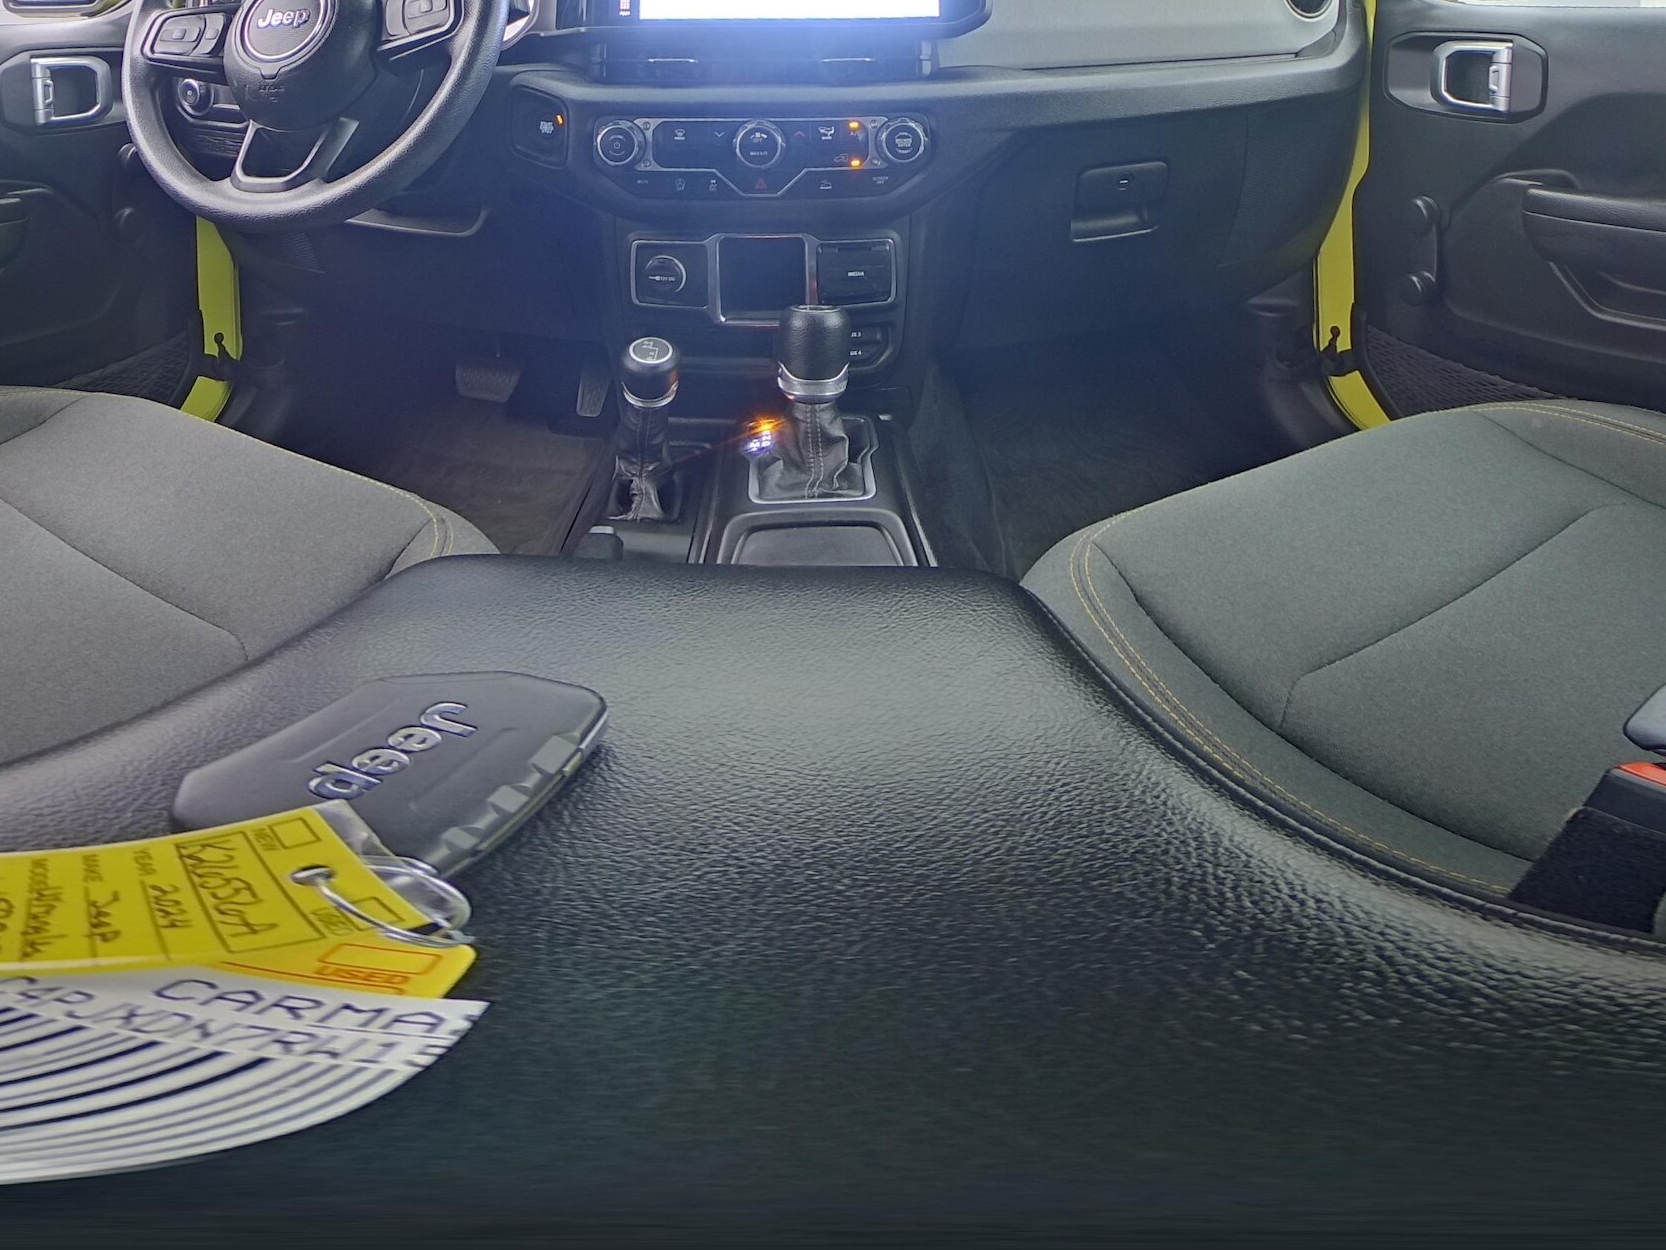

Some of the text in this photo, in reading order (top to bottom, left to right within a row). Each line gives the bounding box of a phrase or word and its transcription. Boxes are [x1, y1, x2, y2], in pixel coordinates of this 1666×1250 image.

[257, 8, 311, 30] Jeep
[305, 699, 480, 805] Jeep
[250, 827, 279, 851] NEW
[82, 854, 103, 883] MAKE
[133, 848, 194, 929] YEAR 2024
[311, 906, 354, 936] USED
[313, 963, 410, 986] USED
